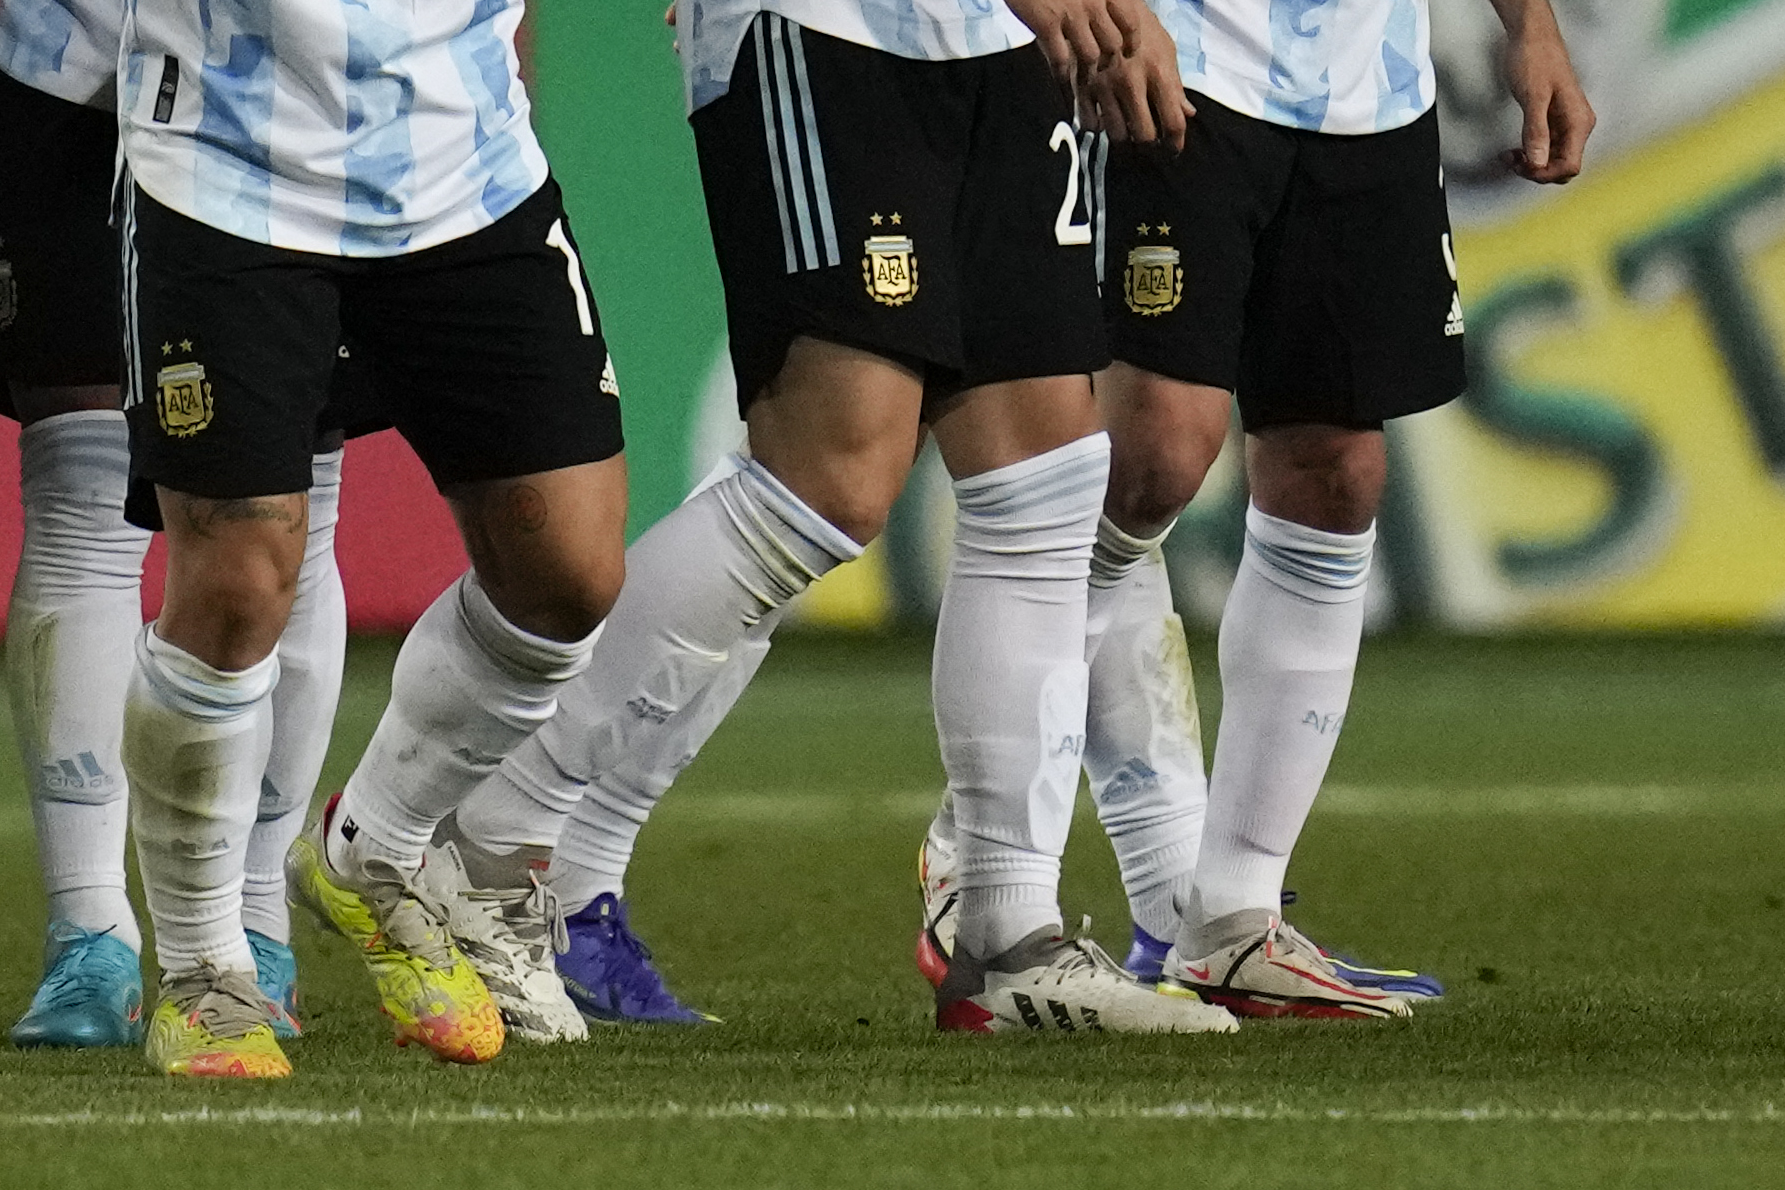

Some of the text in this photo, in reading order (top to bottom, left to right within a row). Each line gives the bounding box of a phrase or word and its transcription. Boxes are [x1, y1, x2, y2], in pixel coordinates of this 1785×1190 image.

[1049, 121, 1092, 245] 2
[545, 217, 595, 336] 1
[877, 254, 907, 286] AFA
[1136, 265, 1169, 296] AFA
